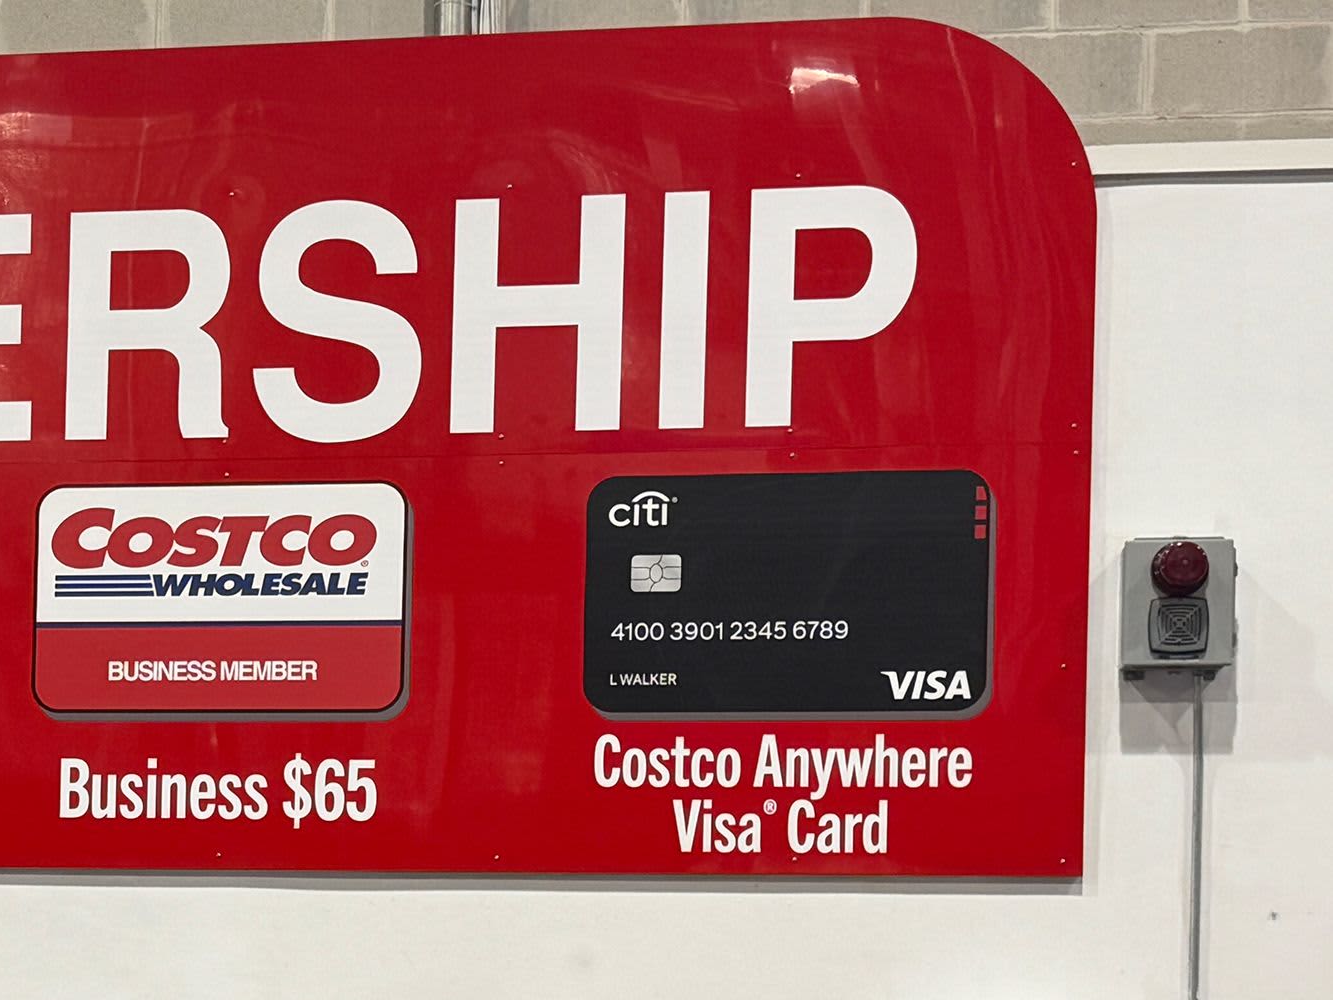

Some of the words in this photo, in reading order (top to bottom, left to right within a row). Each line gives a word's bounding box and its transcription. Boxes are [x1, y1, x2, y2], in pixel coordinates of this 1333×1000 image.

[608, 490, 670, 527] citi
[51, 507, 378, 569] COSTCO
[152, 572, 369, 597] WHOLESALE
[610, 622, 665, 641] 4100
[670, 621, 723, 641] 3901
[730, 621, 787, 640] 2345
[793, 620, 849, 640] 6789
[108, 660, 217, 682] BUSINESS
[220, 660, 319, 682] MEMBER
[609, 673, 617, 687] L
[619, 672, 678, 687] WALKER
[880, 670, 972, 700] VISA
[593, 733, 742, 789] Costco
[753, 733, 974, 801] Anywhere
[59, 757, 268, 821] Business
[281, 752, 378, 830] $65
[787, 798, 888, 854] Card
